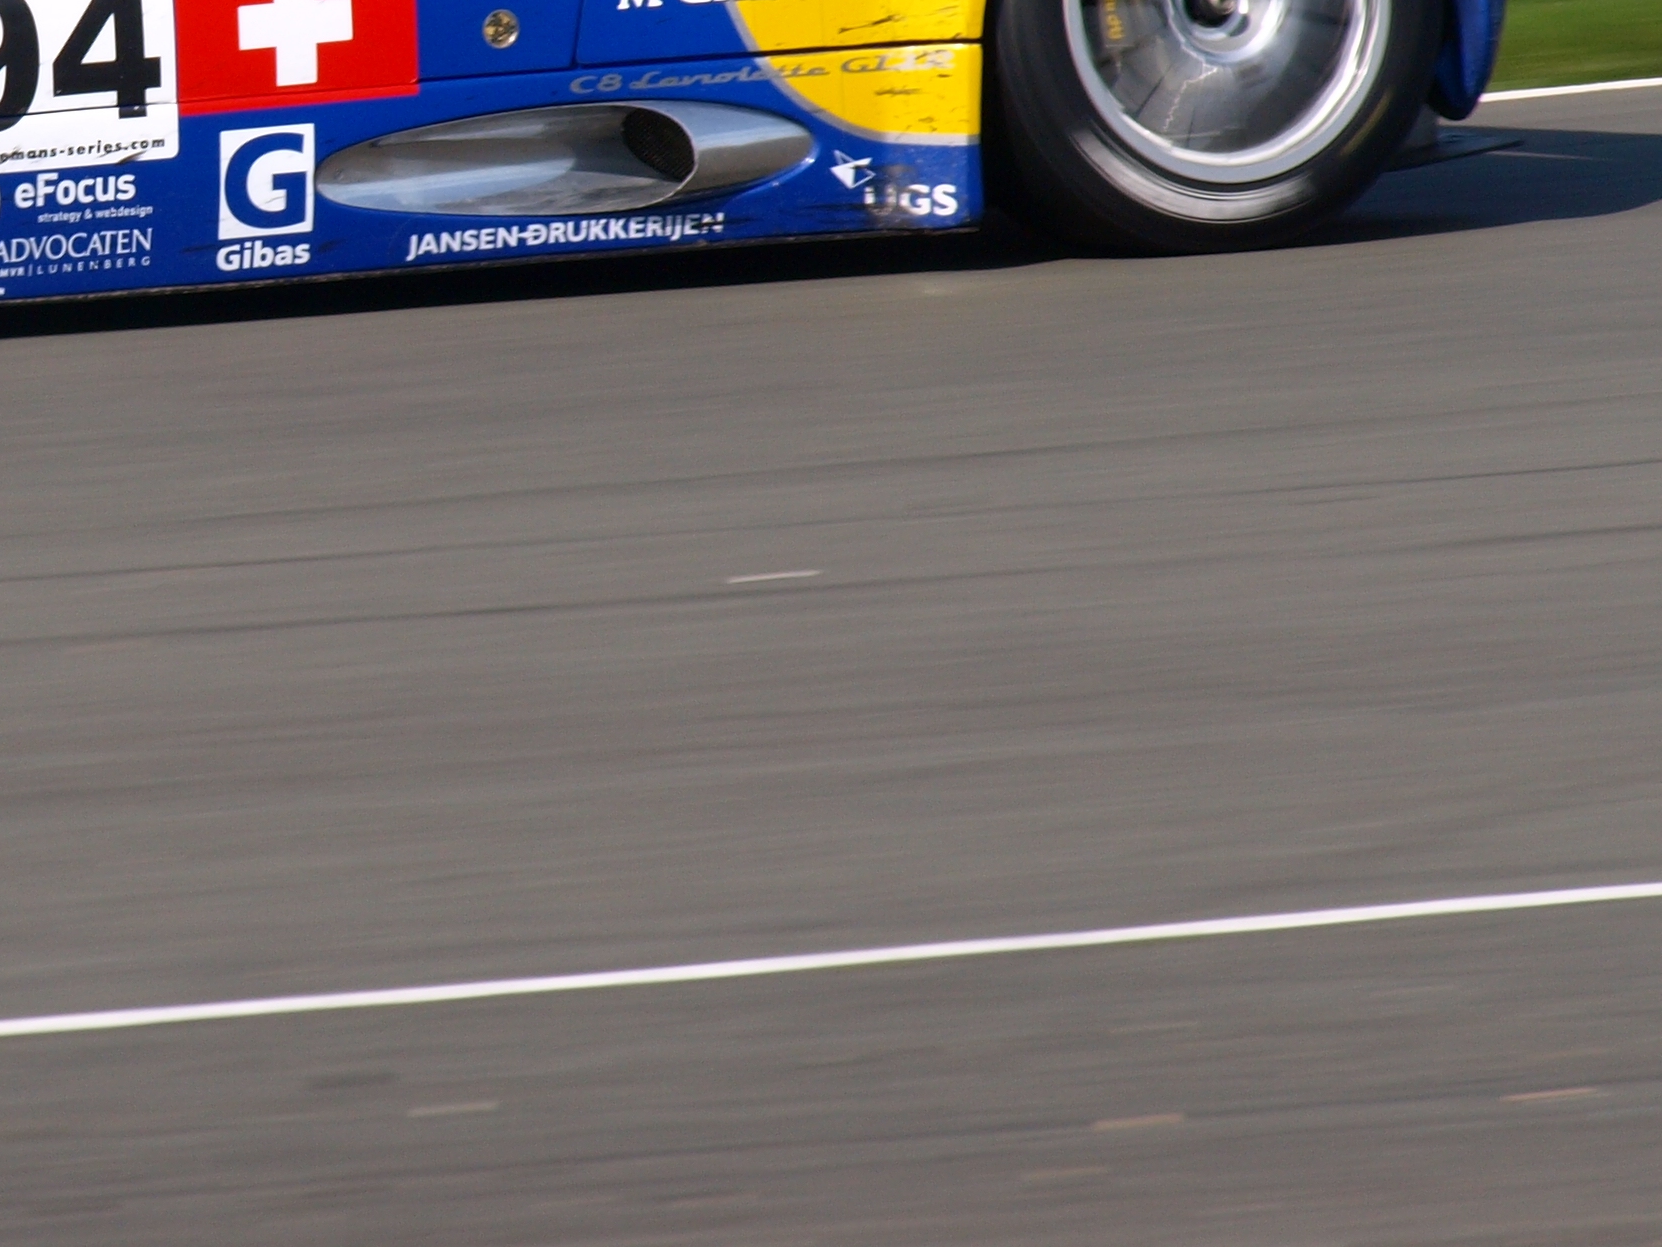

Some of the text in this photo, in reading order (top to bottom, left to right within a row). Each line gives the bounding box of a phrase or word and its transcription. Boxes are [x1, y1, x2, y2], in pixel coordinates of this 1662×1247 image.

[569, 73, 623, 95] C8
[14, 172, 137, 209] eFocus
[37, 210, 83, 223] strategy
[94, 204, 154, 218] webdesign
[215, 239, 311, 272] Gibas
